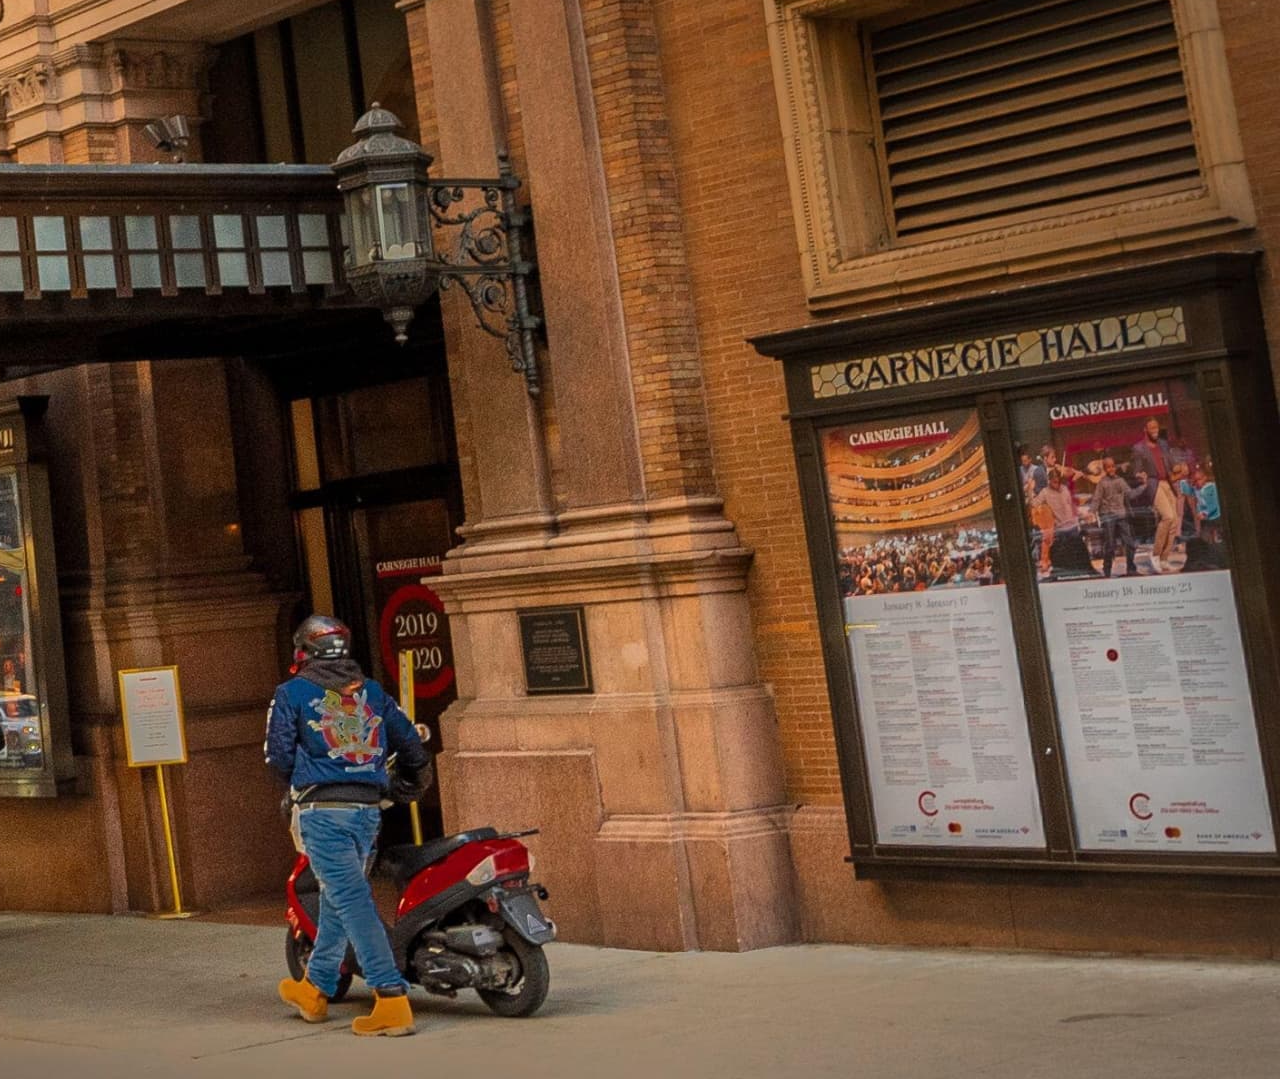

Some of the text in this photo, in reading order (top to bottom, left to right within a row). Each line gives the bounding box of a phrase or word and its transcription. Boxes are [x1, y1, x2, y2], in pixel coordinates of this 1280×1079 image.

[843, 317, 1146, 391] CARNEGIE HALL
[1049, 392, 1169, 421] CARNEGIE HALL
[848, 420, 950, 447] CARNEGIE HALL
[376, 557, 419, 572] CARNEGIE
[395, 612, 438, 637] 2019
[400, 646, 443, 671] 020
